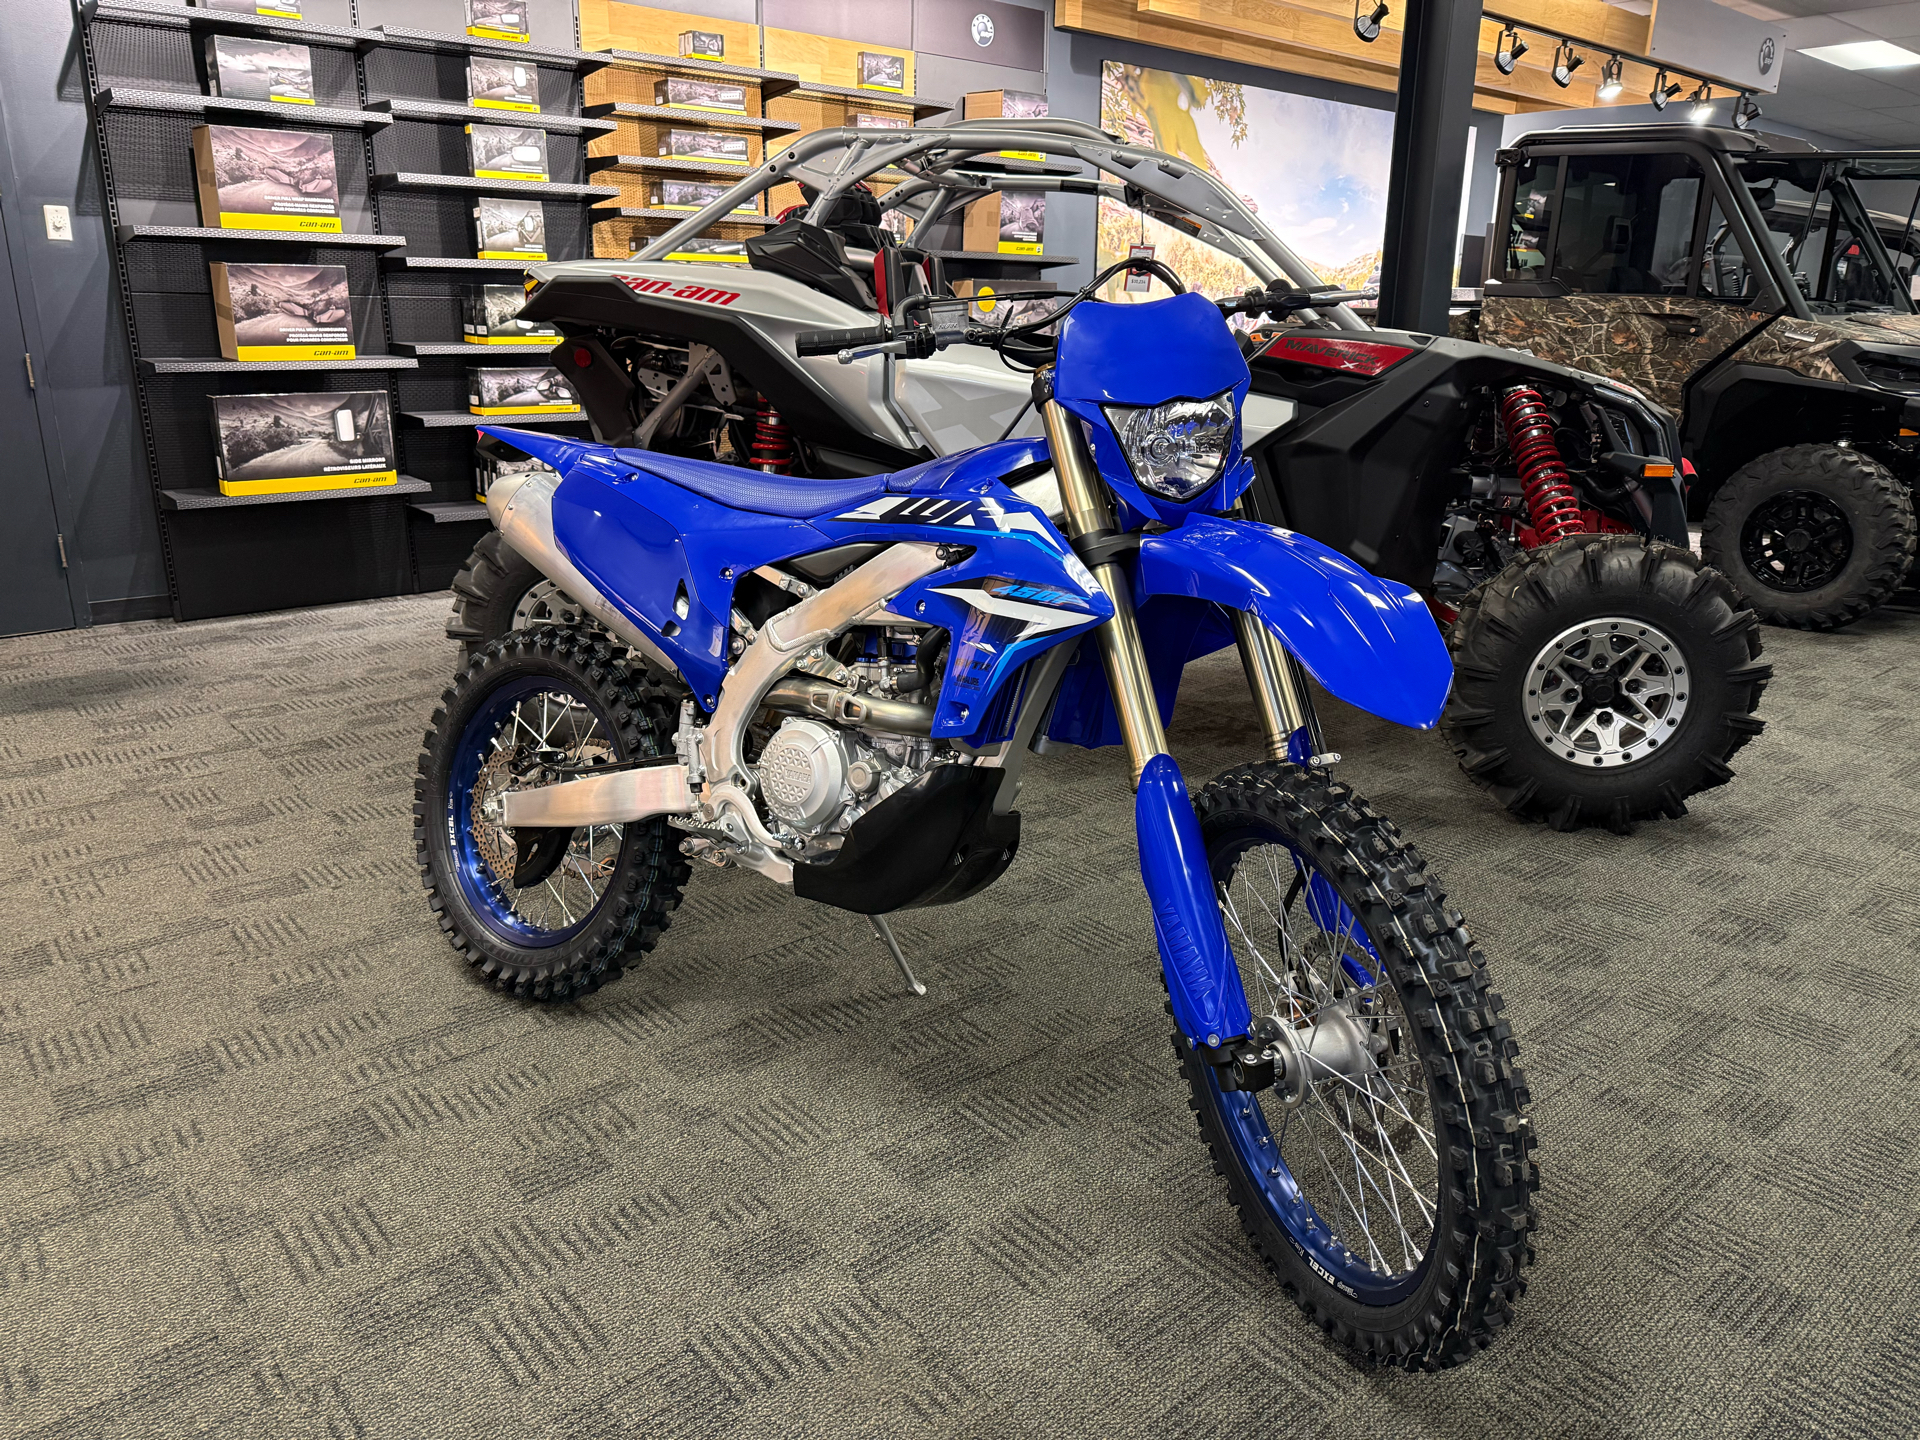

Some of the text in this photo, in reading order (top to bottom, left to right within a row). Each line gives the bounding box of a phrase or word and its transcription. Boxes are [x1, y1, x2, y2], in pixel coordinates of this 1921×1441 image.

[1284, 339, 1380, 366] MAVERICK
[353, 476, 387, 484] can-am
[785, 768, 811, 784] YAMAHA
[448, 815, 456, 846] EXCEL
[1157, 897, 1215, 1001] YAMAHA
[1308, 1256, 1336, 1286] EXCEL
